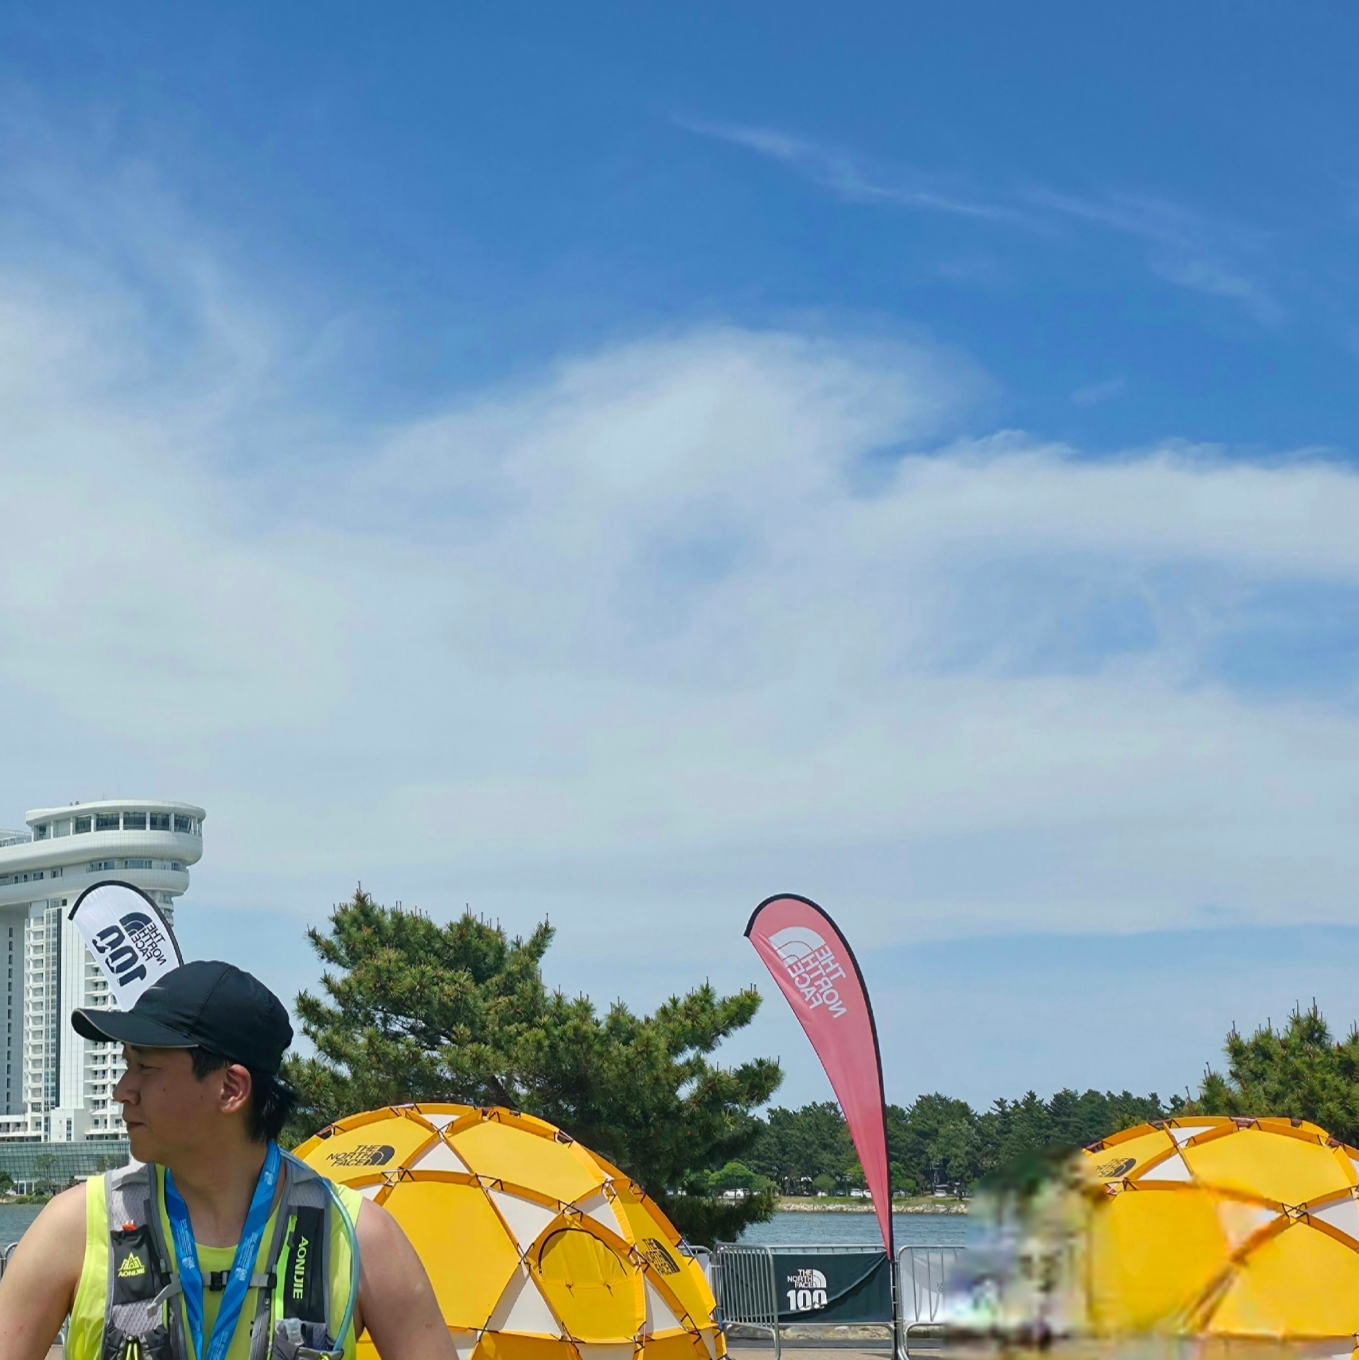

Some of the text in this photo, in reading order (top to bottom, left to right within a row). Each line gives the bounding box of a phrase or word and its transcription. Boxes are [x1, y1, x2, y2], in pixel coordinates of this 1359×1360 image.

[354, 1144, 381, 1153] THE
[326, 1151, 373, 1161] NORTH
[331, 1159, 368, 1167] FACE
[293, 1235, 309, 1299] AONIJIE
[798, 1268, 813, 1277] THE
[787, 1275, 813, 1283] NORTH
[786, 1289, 828, 1311] 100
